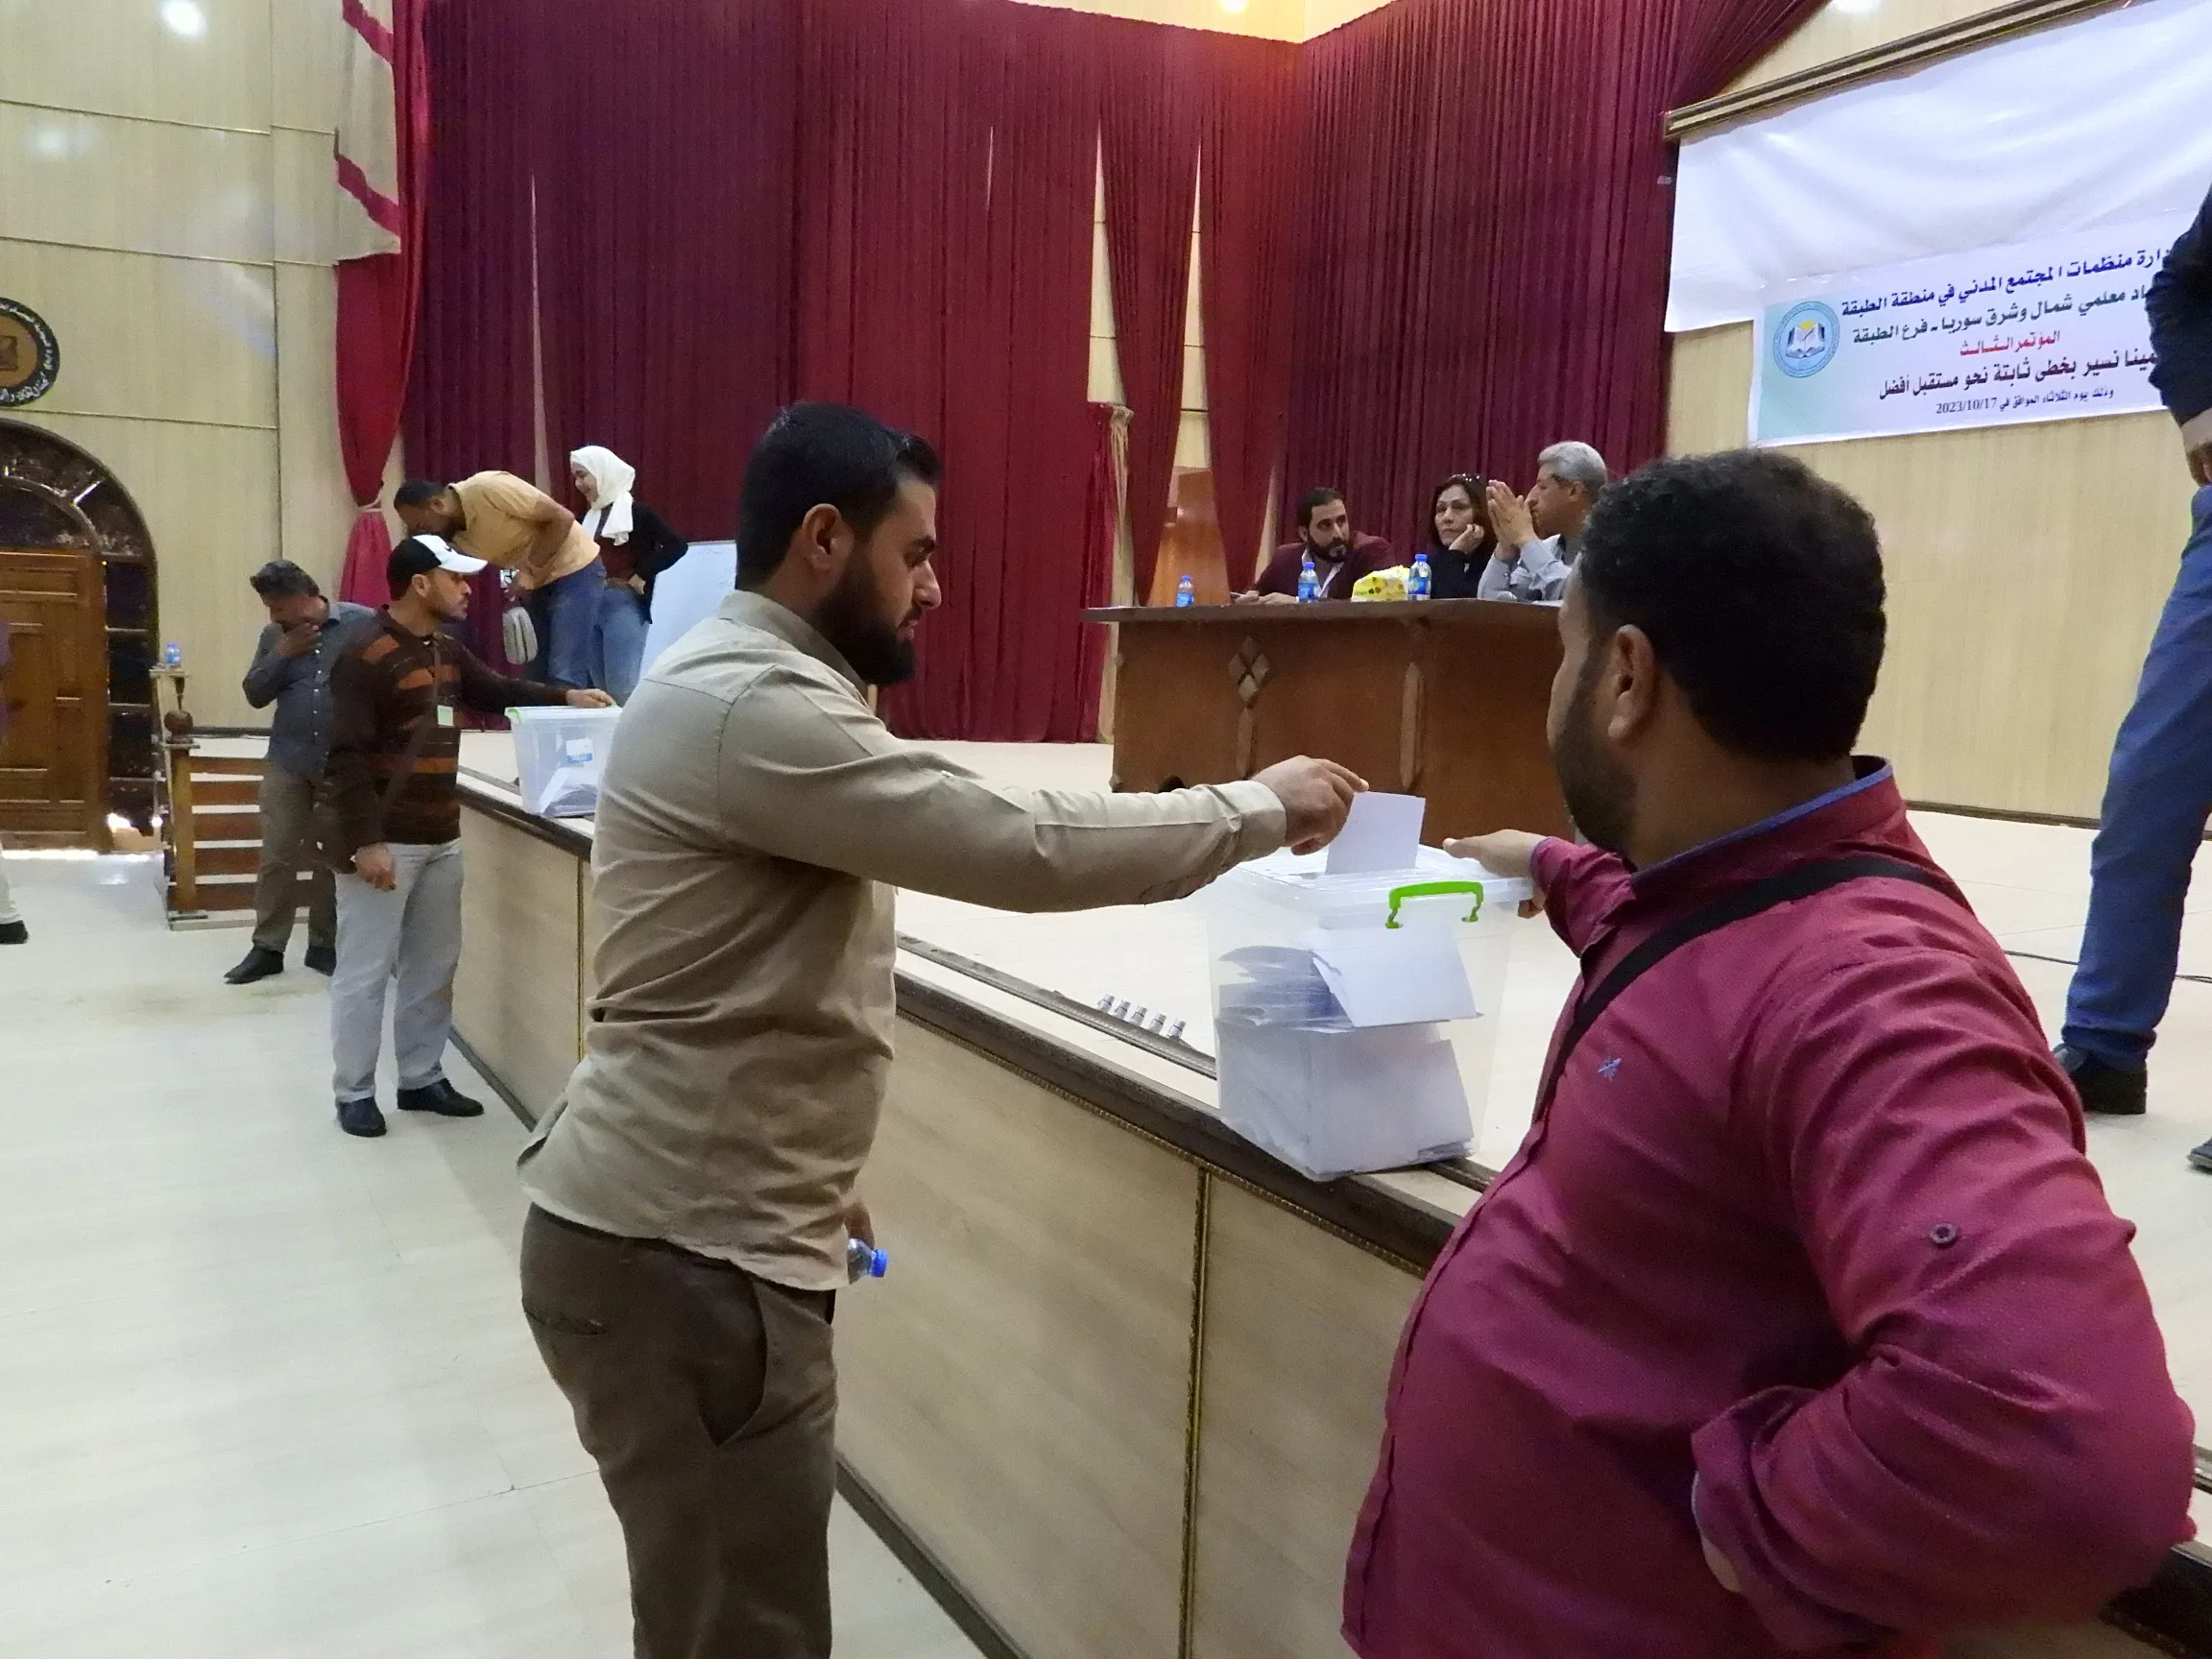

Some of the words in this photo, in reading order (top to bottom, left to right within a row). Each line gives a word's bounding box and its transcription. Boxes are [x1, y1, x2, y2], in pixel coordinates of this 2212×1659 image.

[2067, 253, 2132, 277] منظمات
[1958, 276, 2003, 303] المدني
[2006, 265, 2062, 294] المجتمع
[1890, 289, 1936, 307] منطقة
[1937, 283, 1956, 307] في
[2078, 290, 2126, 316] معلمي
[1841, 297, 1887, 318] الطبقة
[1985, 302, 2028, 326] وشرق
[2031, 293, 2073, 321] شمال
[1852, 325, 1899, 346] الطبقة
[1902, 318, 1928, 341] فرع
[1941, 316, 1983, 334] سوريا
[1960, 334, 2014, 356] الثالث
[2014, 329, 2060, 352] المؤتمر
[1993, 356, 2032, 387] ثابتة
[2034, 356, 2077, 383] بخطى
[2082, 349, 2120, 376] نسير
[1879, 373, 1910, 400] أفضل
[1912, 373, 1959, 397] مستقبل
[1963, 366, 1988, 391] نحو
[2012, 395, 2040, 409] الموافق
[2042, 389, 2072, 404] الثلاثاء
[2073, 392, 2088, 403] يوم
[2092, 386, 2114, 399] وذلك
[1936, 397, 1997, 415] 2023/10/17
[1999, 398, 2009, 413] في
